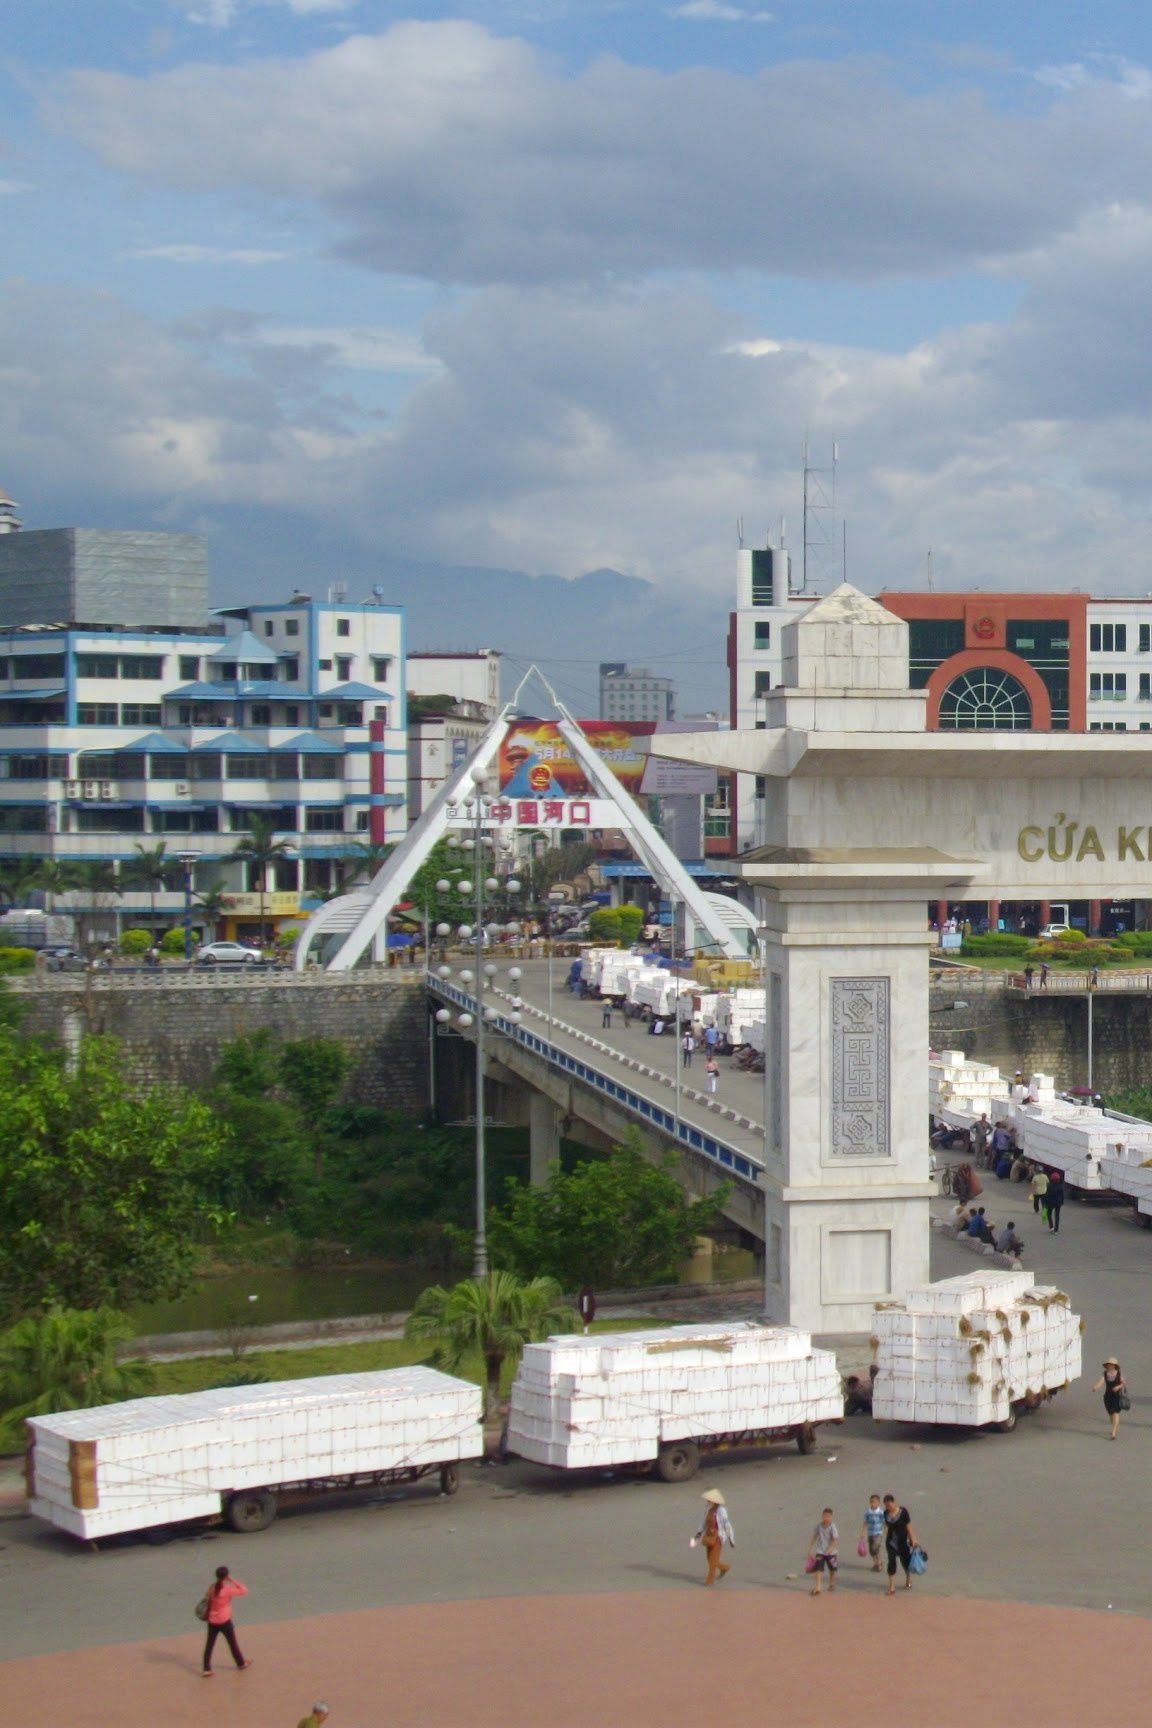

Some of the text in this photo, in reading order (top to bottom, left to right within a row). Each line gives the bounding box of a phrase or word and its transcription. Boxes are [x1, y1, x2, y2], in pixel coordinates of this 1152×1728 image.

[491, 801, 590, 825] 中国河口
[1017, 812, 1105, 862] CỬA
